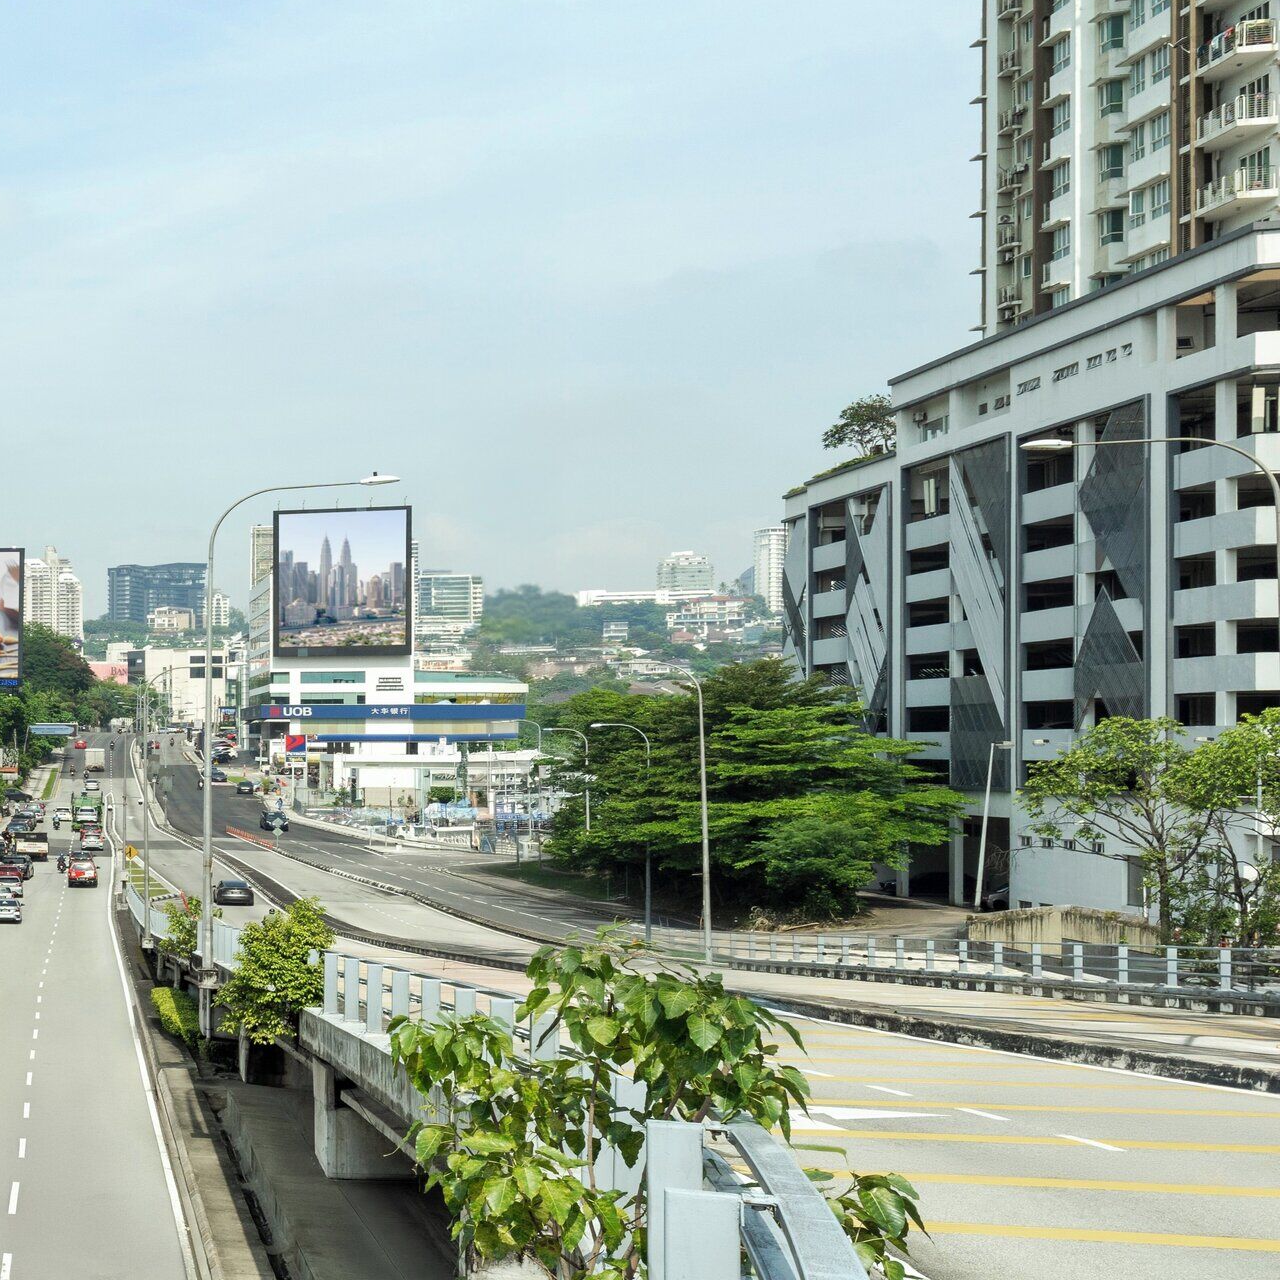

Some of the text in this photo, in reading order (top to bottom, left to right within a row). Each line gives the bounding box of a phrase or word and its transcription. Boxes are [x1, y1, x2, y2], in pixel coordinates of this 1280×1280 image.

[283, 706, 313, 717] UOB
[370, 707, 409, 715] 大华银行
